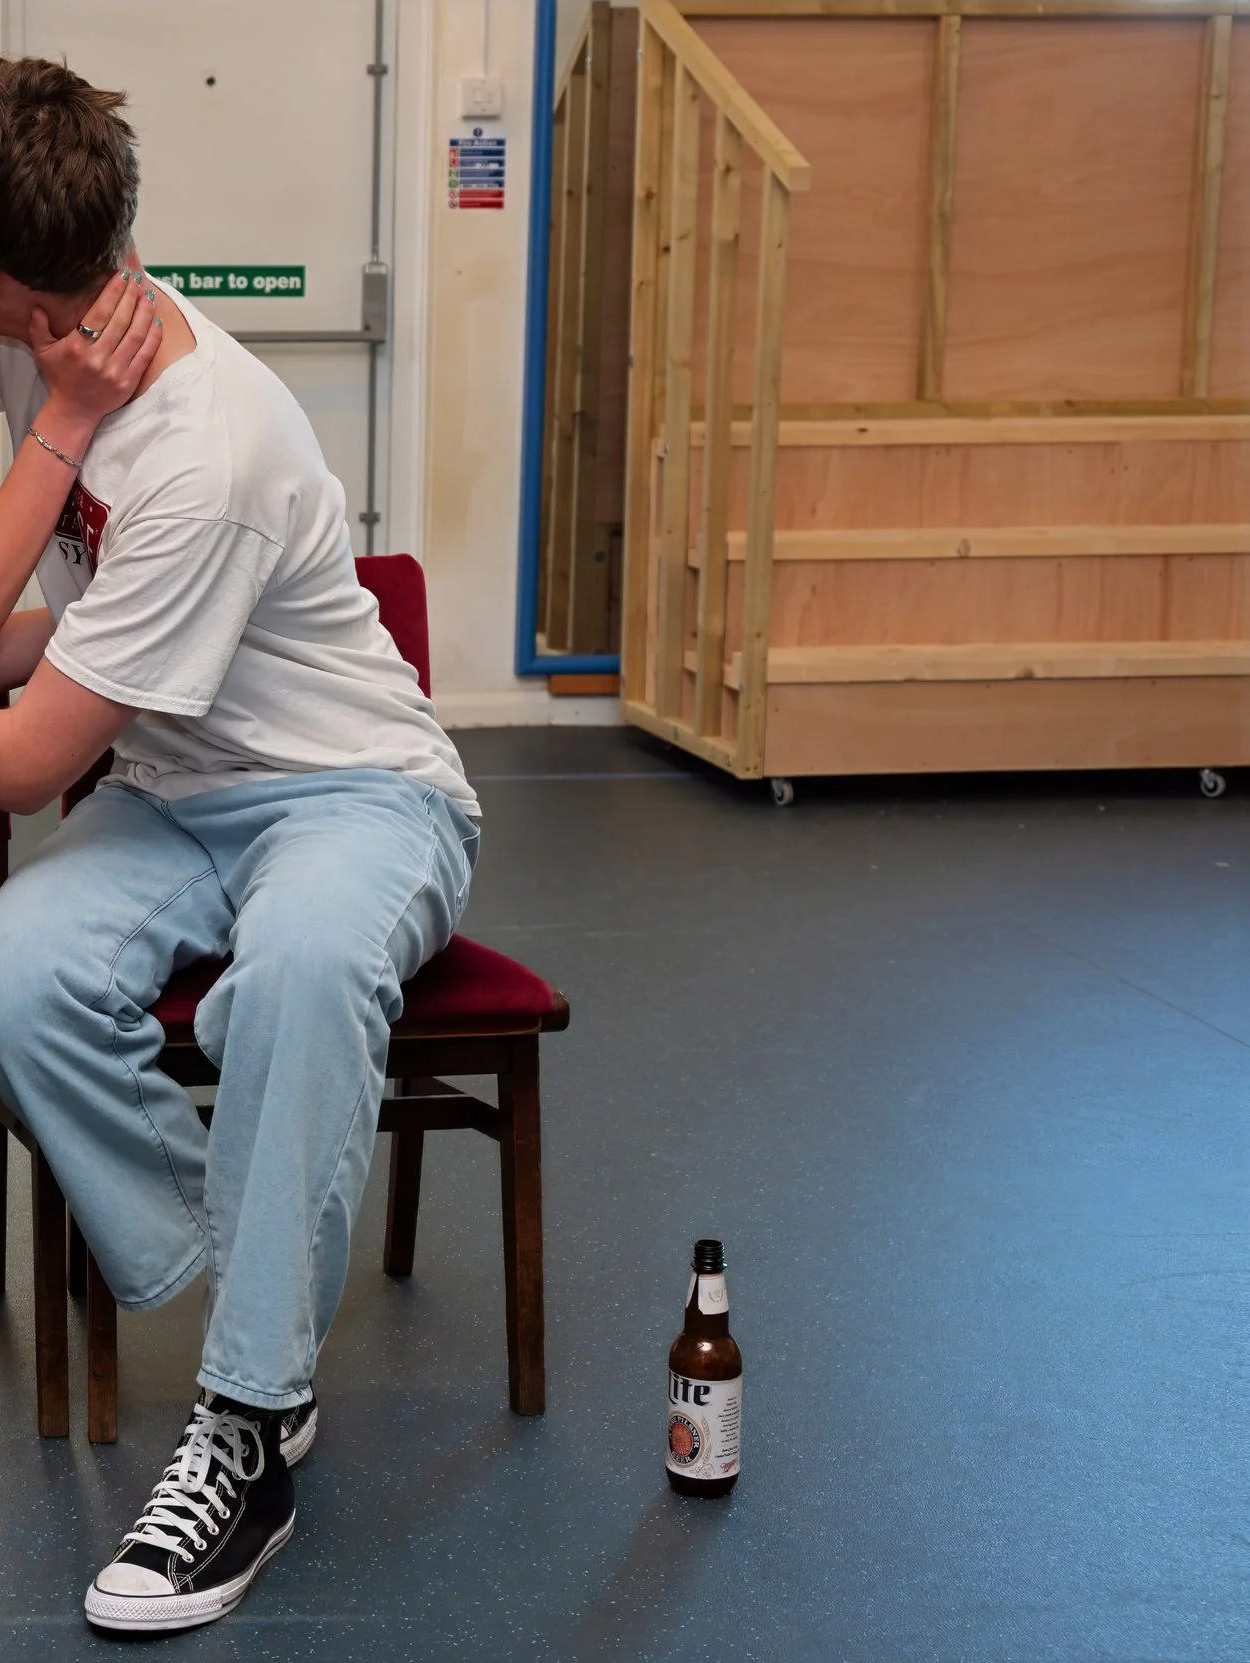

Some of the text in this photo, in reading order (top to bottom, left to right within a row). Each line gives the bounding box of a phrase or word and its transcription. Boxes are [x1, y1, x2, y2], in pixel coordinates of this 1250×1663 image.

[155, 272, 301, 293] sh bar to open
